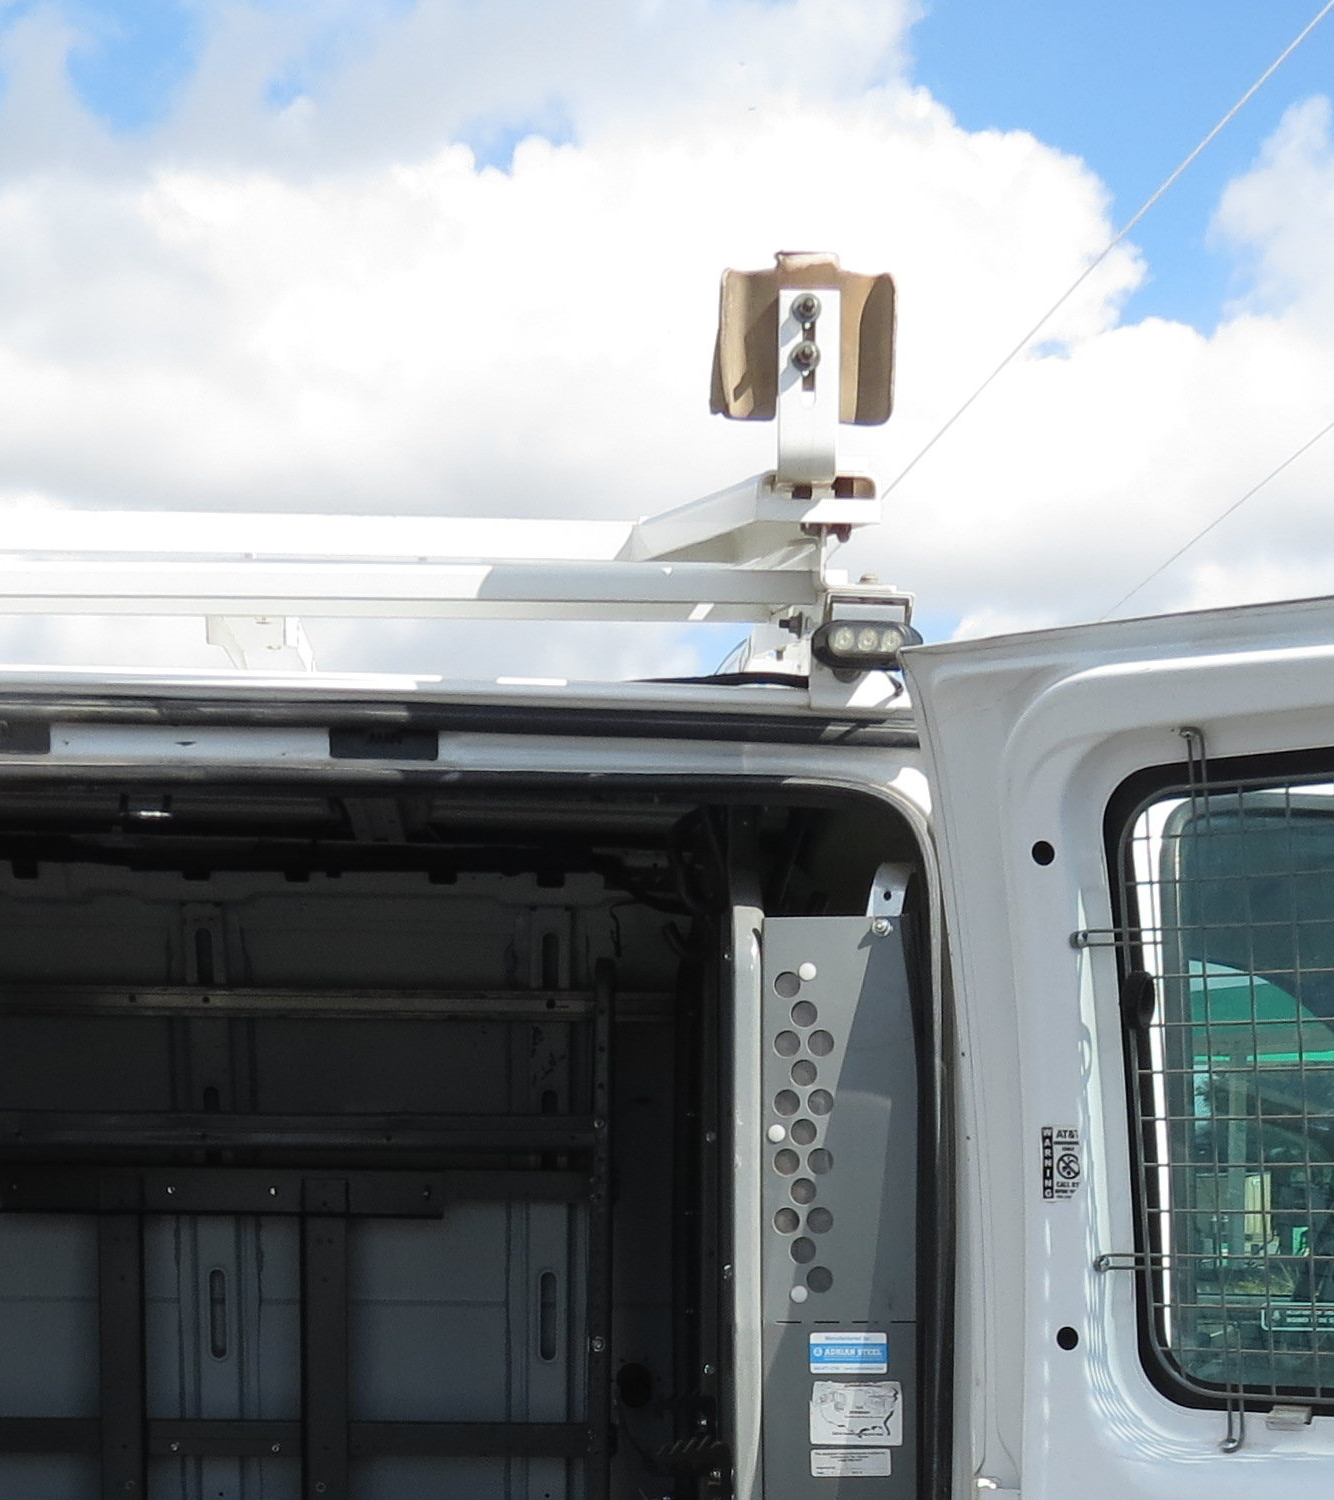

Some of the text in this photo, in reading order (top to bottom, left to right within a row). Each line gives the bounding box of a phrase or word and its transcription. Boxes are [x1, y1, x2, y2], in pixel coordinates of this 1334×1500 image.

[1042, 1128, 1053, 1198] WARNING
[824, 1348, 882, 1356] ADRIAN STEEL
